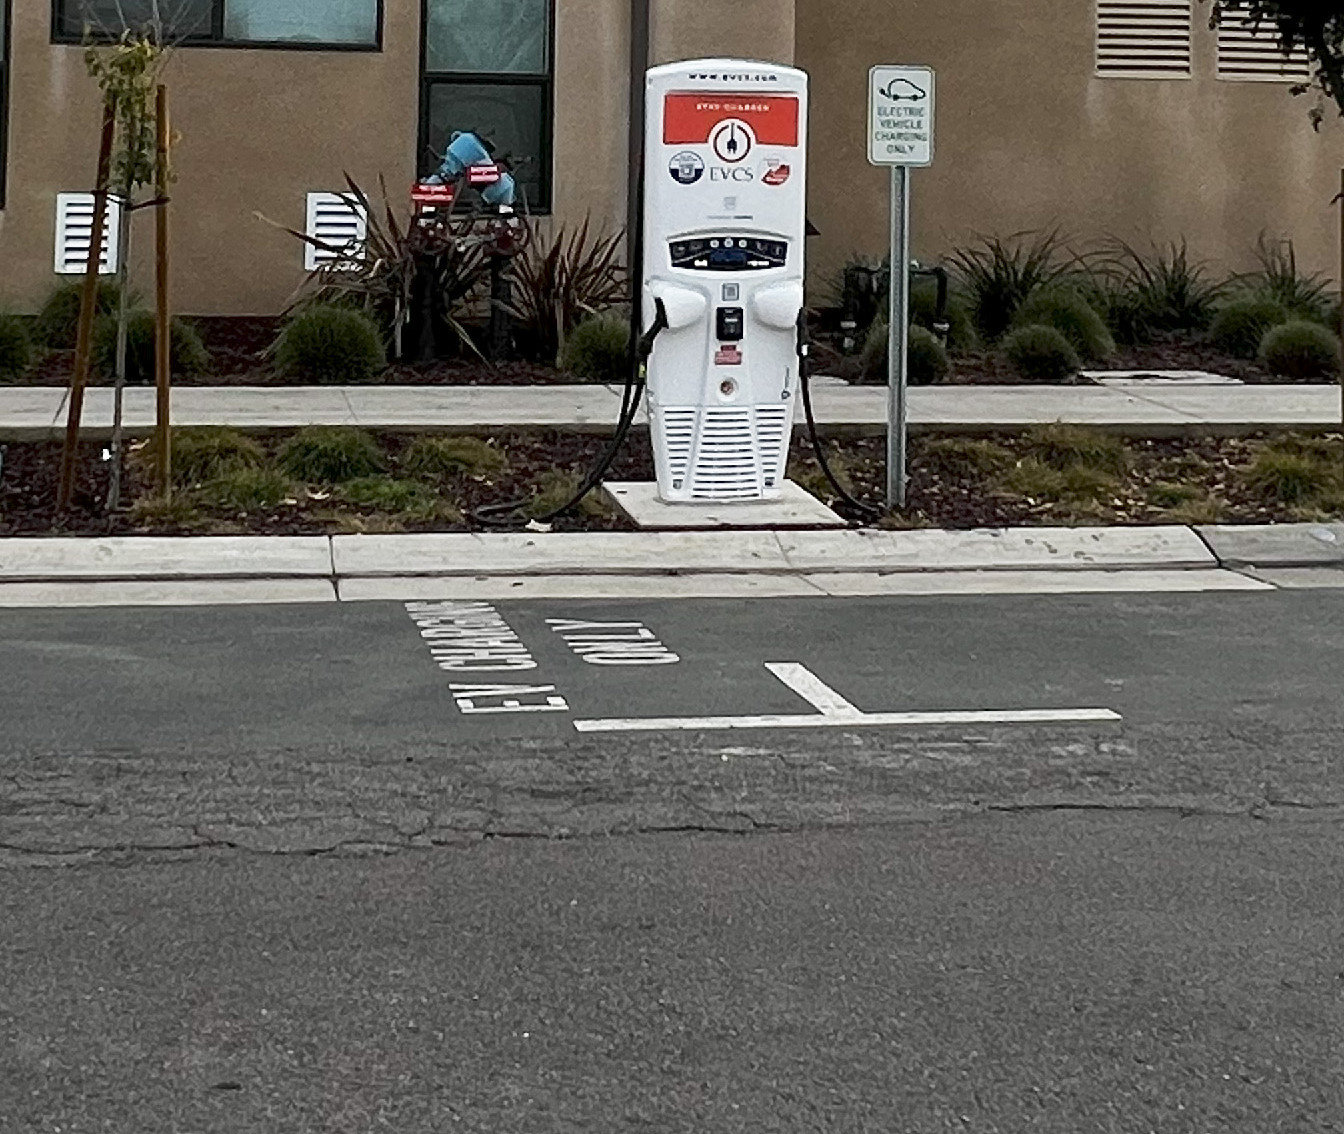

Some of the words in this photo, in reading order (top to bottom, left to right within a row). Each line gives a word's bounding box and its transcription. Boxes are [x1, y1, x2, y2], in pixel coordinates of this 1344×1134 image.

[877, 107, 924, 117] ELECTRIC
[878, 119, 923, 129] VEHICLE
[875, 131, 928, 142] CHARGING
[886, 144, 915, 154] ONLY
[709, 166, 754, 182] EVCS
[544, 617, 680, 665] ONLY
[448, 683, 570, 714] EV
